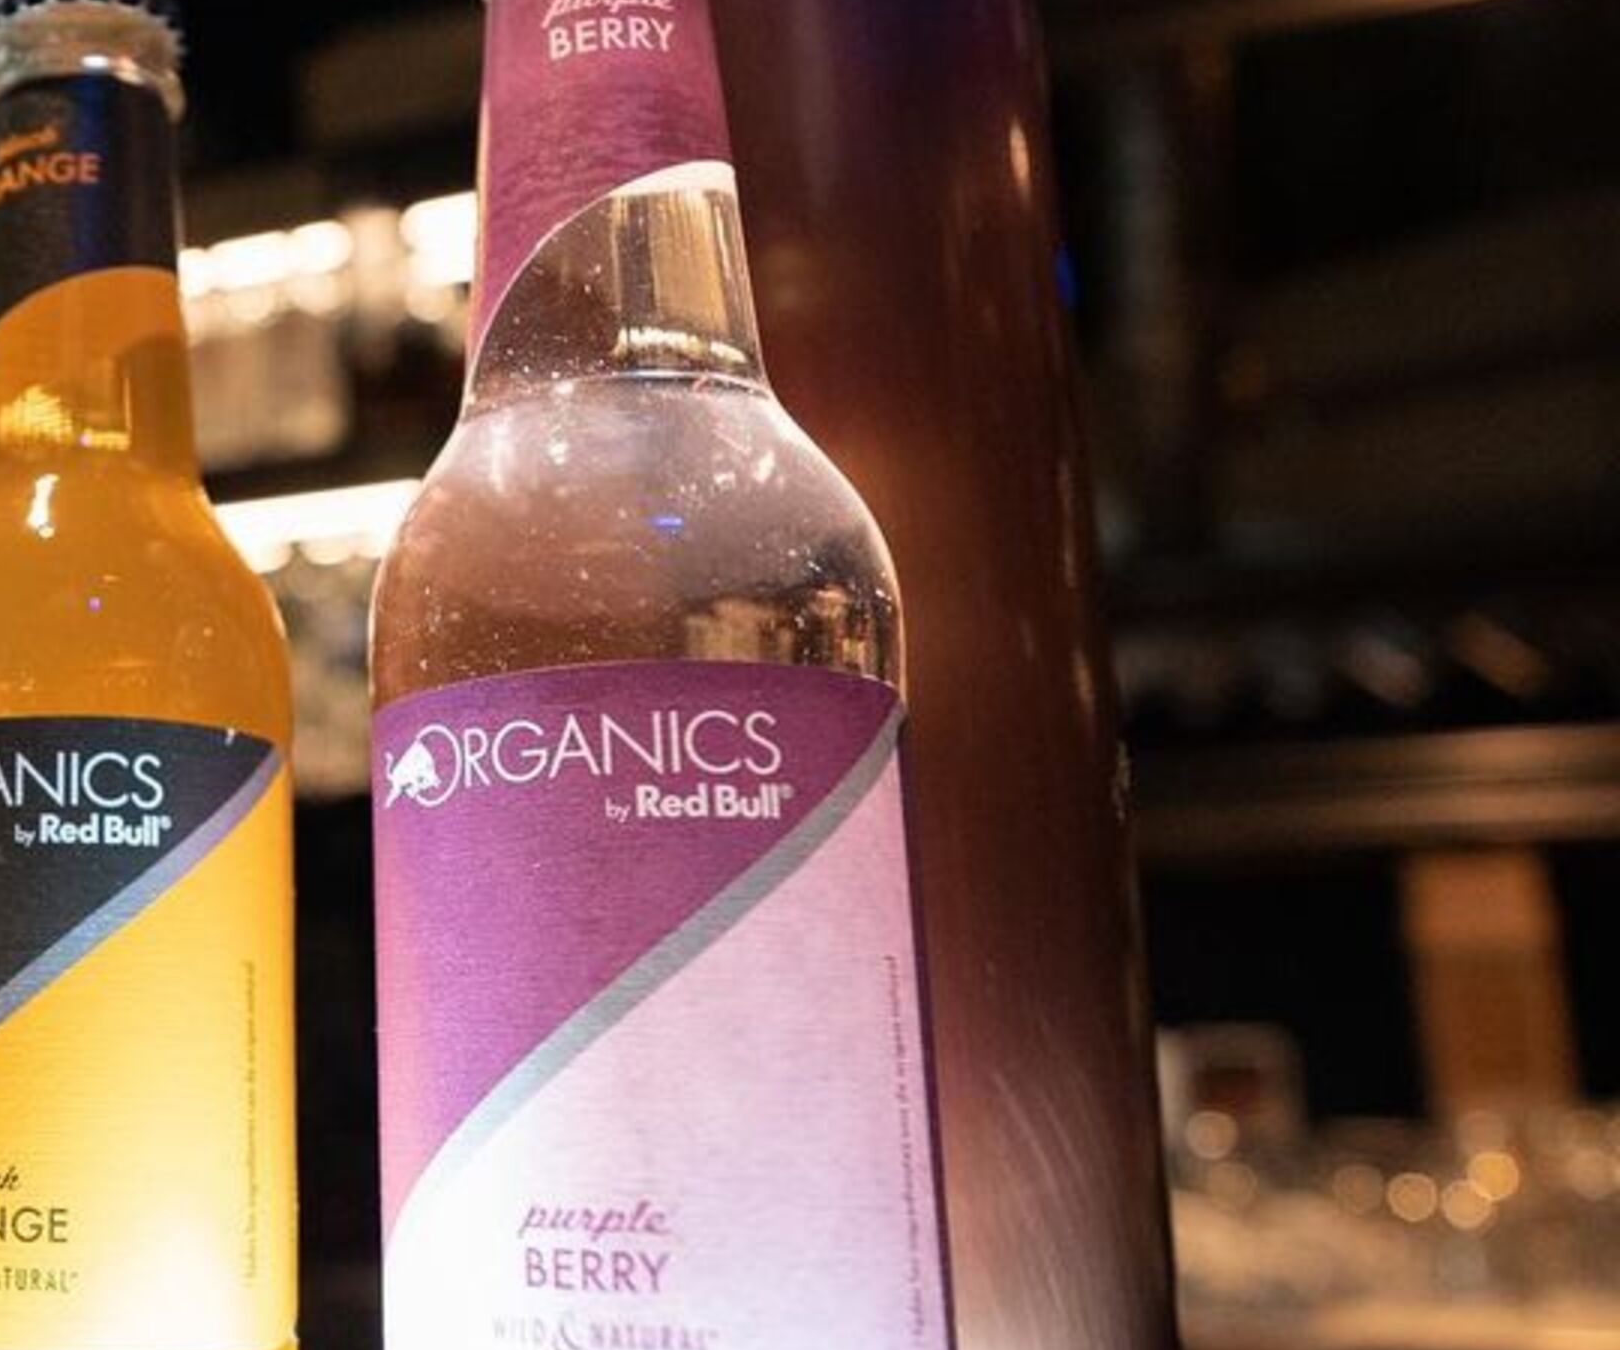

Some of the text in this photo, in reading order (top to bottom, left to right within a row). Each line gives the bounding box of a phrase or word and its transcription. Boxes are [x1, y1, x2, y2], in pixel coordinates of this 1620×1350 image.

[548, 18, 675, 60] BERRY
[410, 710, 782, 807] ORGANICS
[605, 798, 631, 823] by
[635, 782, 709, 818] Red
[13, 823, 36, 848] by
[38, 812, 100, 845] Red
[516, 1197, 673, 1242] purple
[524, 1246, 672, 1294] BERRY
